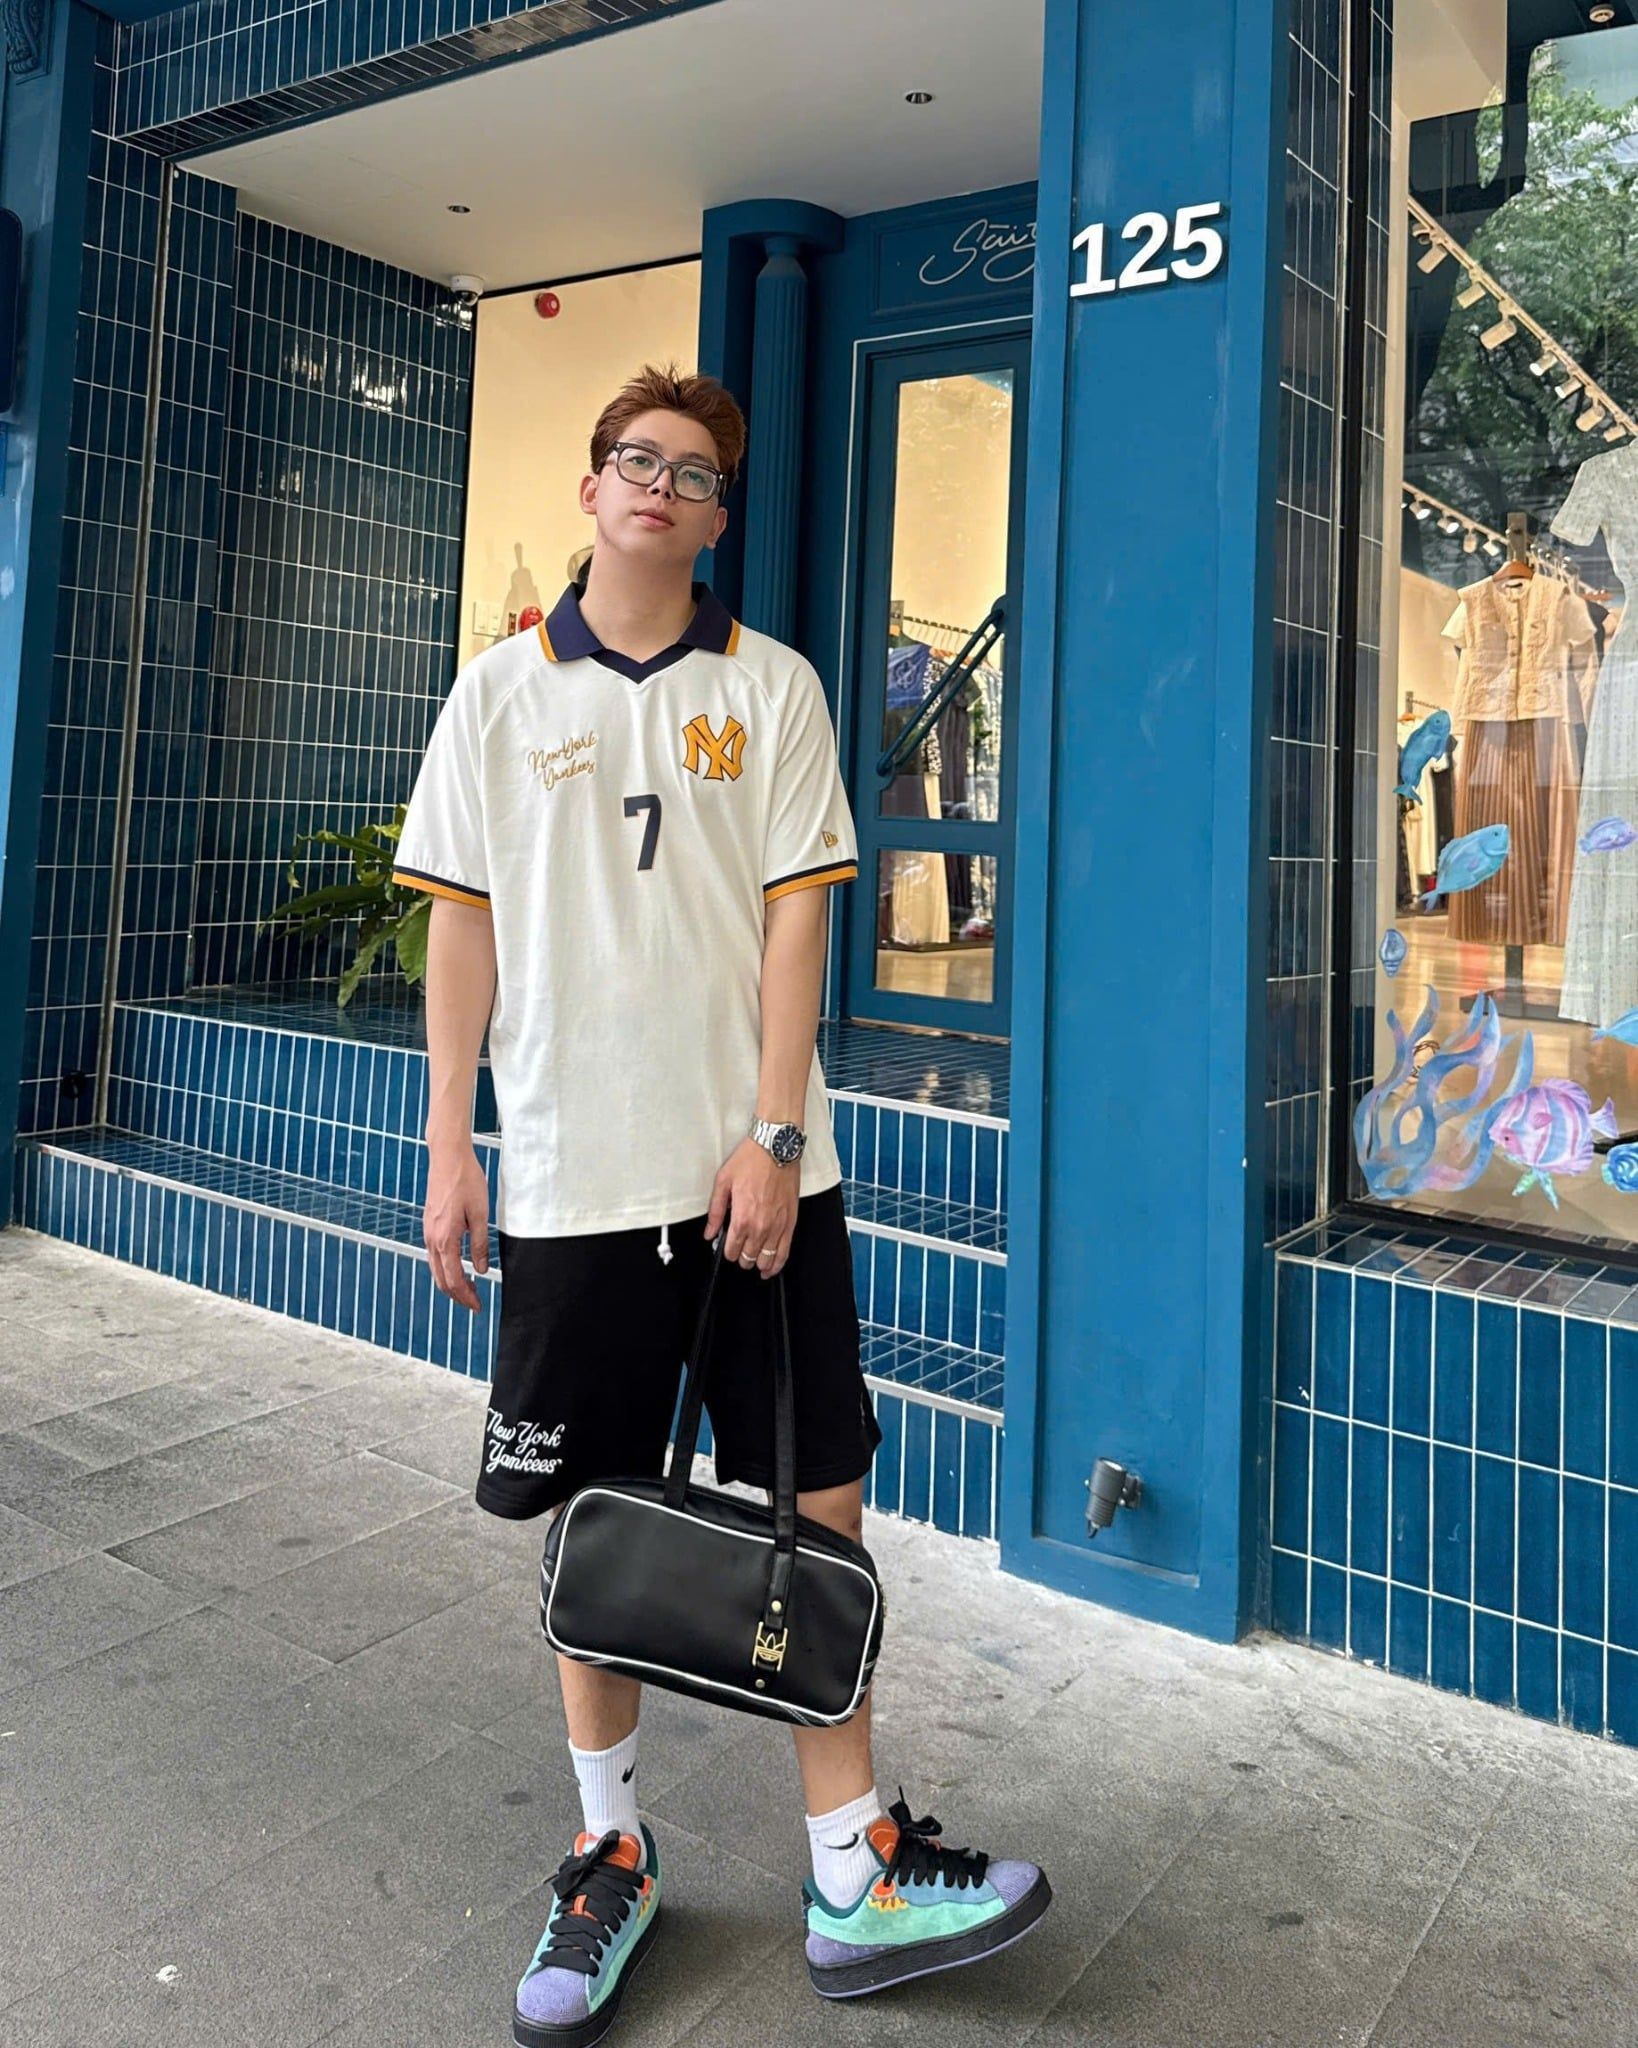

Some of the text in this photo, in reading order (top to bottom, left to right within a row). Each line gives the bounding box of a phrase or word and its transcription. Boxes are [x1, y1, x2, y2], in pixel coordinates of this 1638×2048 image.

[1070, 200, 1223, 298] 125
[527, 730, 598, 775] New York
[682, 713, 748, 782] NY
[543, 759, 596, 792] Yankees
[623, 793, 662, 872] 7
[486, 1406, 566, 1455] New York
[485, 1438, 559, 1474] Yankees
